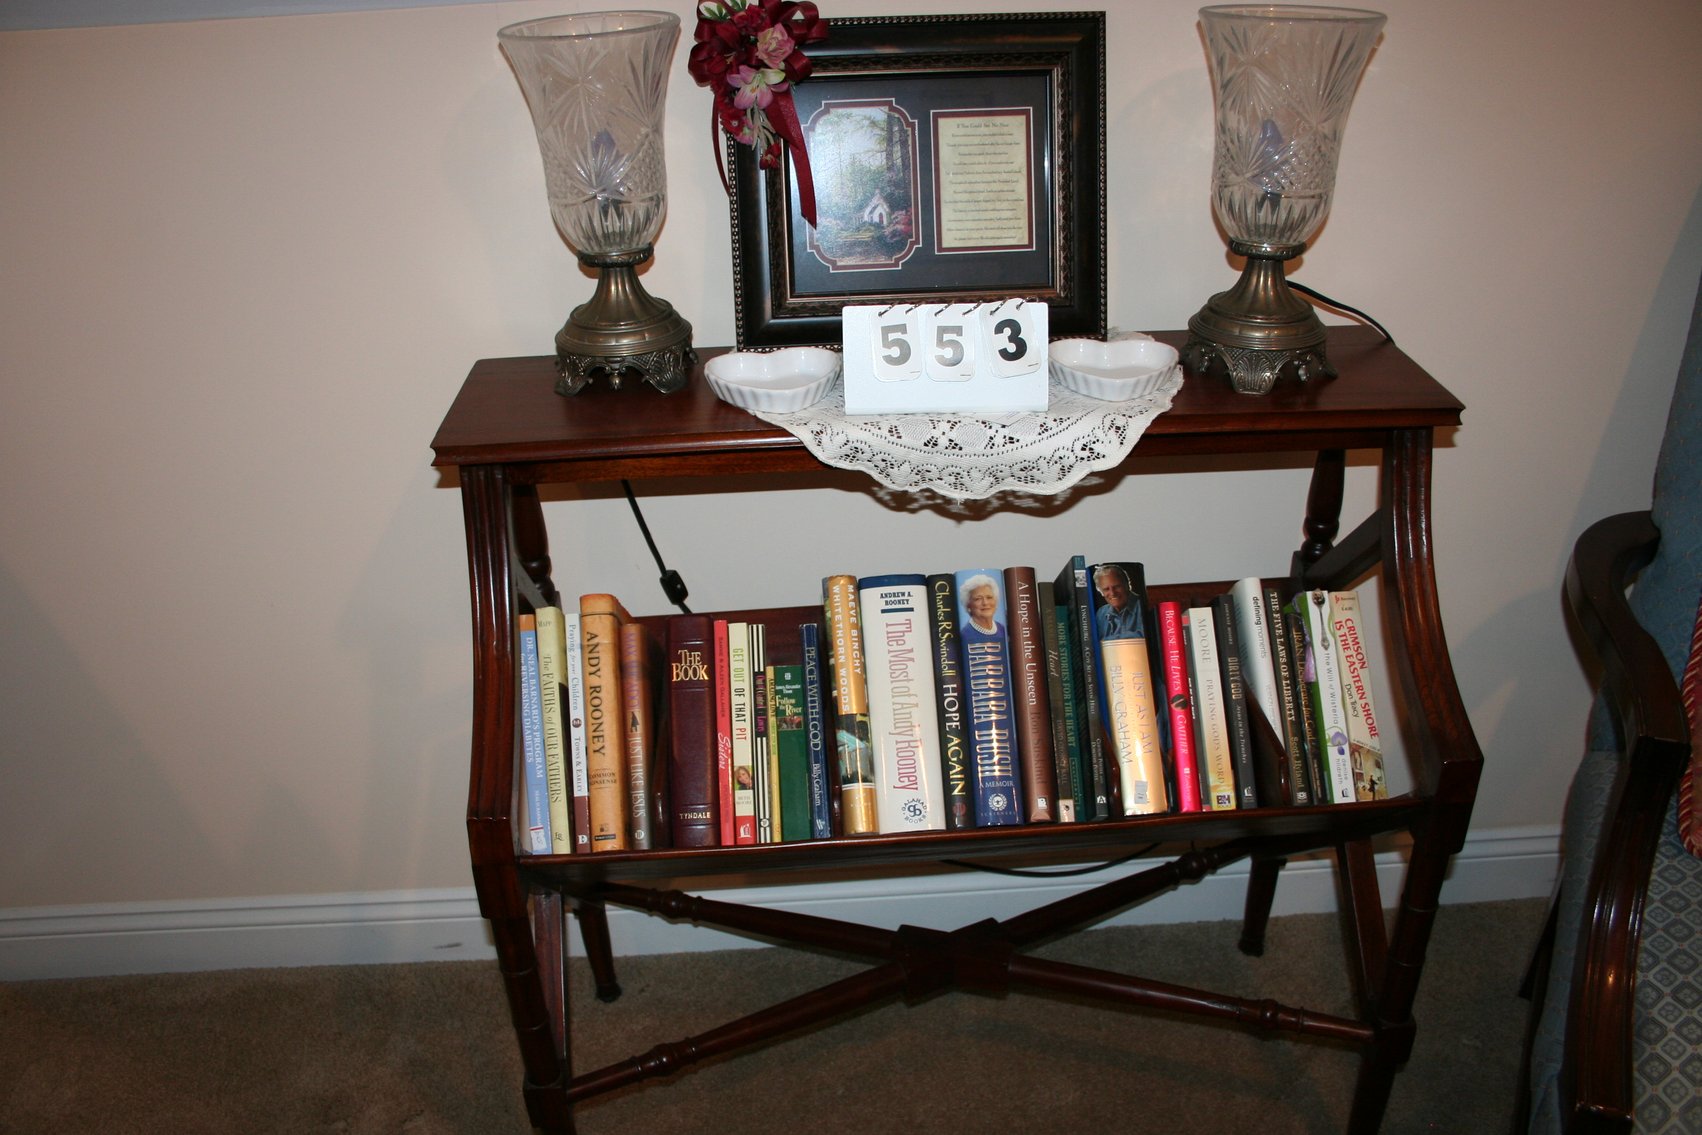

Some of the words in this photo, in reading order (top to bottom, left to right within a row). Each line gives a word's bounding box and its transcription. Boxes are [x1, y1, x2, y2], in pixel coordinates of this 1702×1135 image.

[1018, 582, 1029, 590] A
[847, 584, 857, 623] MAEVE
[935, 581, 952, 620] Charles
[1018, 594, 1030, 623] Hope
[1270, 592, 1279, 611] THE
[885, 619, 912, 646] The
[938, 621, 952, 632] R.
[1023, 627, 1032, 637] in
[1057, 622, 1065, 645] MORE
[1080, 605, 1088, 641] LYNCHBURG
[1165, 610, 1175, 646] BECAUSE
[1273, 613, 1282, 636] FIVE
[1335, 620, 1344, 631] IS
[526, 637, 534, 651] DR.
[568, 624, 576, 652] Praying
[832, 585, 845, 662] WHITETHORN
[840, 668, 850, 712] WOODS
[851, 629, 861, 674] BINCHY
[1024, 641, 1035, 658] the
[1276, 638, 1287, 663] LAWS
[1294, 631, 1304, 656] IRAN
[1339, 632, 1351, 653] THE
[1345, 618, 1368, 670] CRIMSON
[528, 654, 536, 676] NEAL
[543, 654, 551, 671] The
[587, 632, 601, 678] ANDY
[678, 650, 702, 666] THE
[733, 648, 743, 663] GET
[806, 647, 817, 681] PEACE
[887, 648, 915, 683] Most
[938, 633, 956, 677] Swindoll
[1059, 647, 1069, 681] STORIES
[1169, 650, 1179, 663] HE
[1228, 657, 1240, 680] DIRTY
[672, 663, 709, 682] BOOK
[733, 668, 744, 682] OUT
[968, 642, 1008, 725] BARBARA
[1025, 663, 1037, 705] Unseen
[1109, 666, 1124, 696] BILLY
[1132, 672, 1146, 698] JUST
[1170, 665, 1181, 691] LIVES
[1280, 665, 1288, 678] OF
[1345, 654, 1367, 700] EASTERN
[521, 665, 531, 716] REVERSING
[542, 673, 554, 713] FAITHS
[571, 677, 579, 711] Children
[734, 688, 745, 698] OF
[808, 684, 819, 718] WITH
[891, 686, 918, 697] of
[1063, 683, 1072, 699] FOR
[1197, 618, 1211, 664] MOORE
[1206, 679, 1216, 721] PRAYING
[1215, 754, 1225, 785] WORD
[1231, 682, 1242, 699] GOD
[1282, 681, 1295, 721] LIBERTY
[1345, 683, 1354, 700] Don
[530, 679, 540, 730] BARNARD'S
[734, 703, 746, 723] THAT
[943, 684, 960, 731] HOPE
[1065, 702, 1073, 716] THE
[1136, 704, 1147, 720] AS
[1329, 692, 1339, 725] Wisteria
[1349, 700, 1359, 718] Tracy
[546, 717, 554, 725] of
[589, 685, 605, 756] ROONEY
[889, 702, 920, 737] Andy
[1114, 701, 1133, 764] GRAHAM
[1360, 702, 1379, 739] SHORE
[524, 718, 536, 762] DIABETES
[546, 728, 558, 751] OUR
[736, 728, 746, 741] PIT
[810, 721, 821, 751] GOD
[1065, 720, 1075, 747] HEART
[1141, 732, 1152, 754] AM
[1177, 715, 1188, 755] GAITHER
[1290, 736, 1299, 757] Scott
[533, 732, 543, 778] PROGRAM
[629, 737, 643, 760] JUST
[718, 733, 731, 769] Sisters
[975, 730, 1012, 777] BUSH
[631, 764, 644, 786] LIKE
[811, 763, 821, 778] Billy
[893, 739, 922, 790] Rooney
[947, 735, 966, 795] AGAIN
[1293, 760, 1304, 787] Hyland
[1341, 758, 1349, 781] denise
[547, 754, 561, 803] FATHERS
[630, 790, 645, 818] JESUS
[814, 779, 822, 806] Graham
